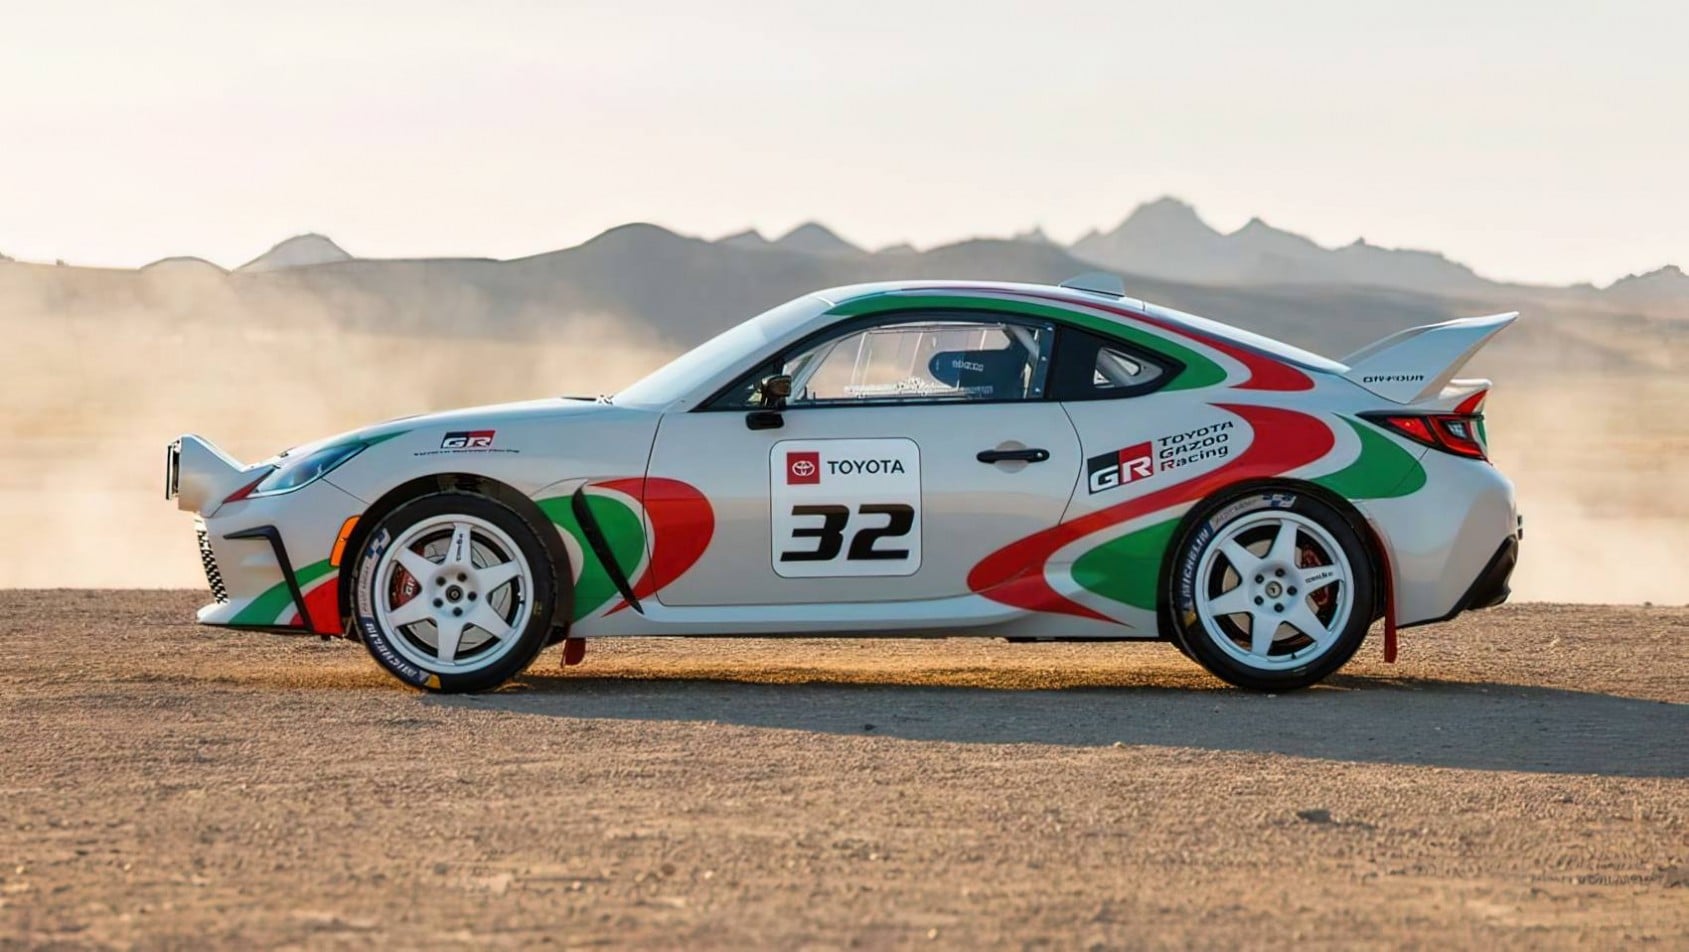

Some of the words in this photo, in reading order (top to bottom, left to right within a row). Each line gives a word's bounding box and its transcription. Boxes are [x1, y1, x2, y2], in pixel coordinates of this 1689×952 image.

[1157, 421, 1234, 447] TOYOTA
[1159, 433, 1229, 460] GAZOO
[827, 459, 905, 475] TOYOTA
[1160, 446, 1229, 472] Racing
[1089, 454, 1152, 493] GR
[780, 503, 915, 562] 32
